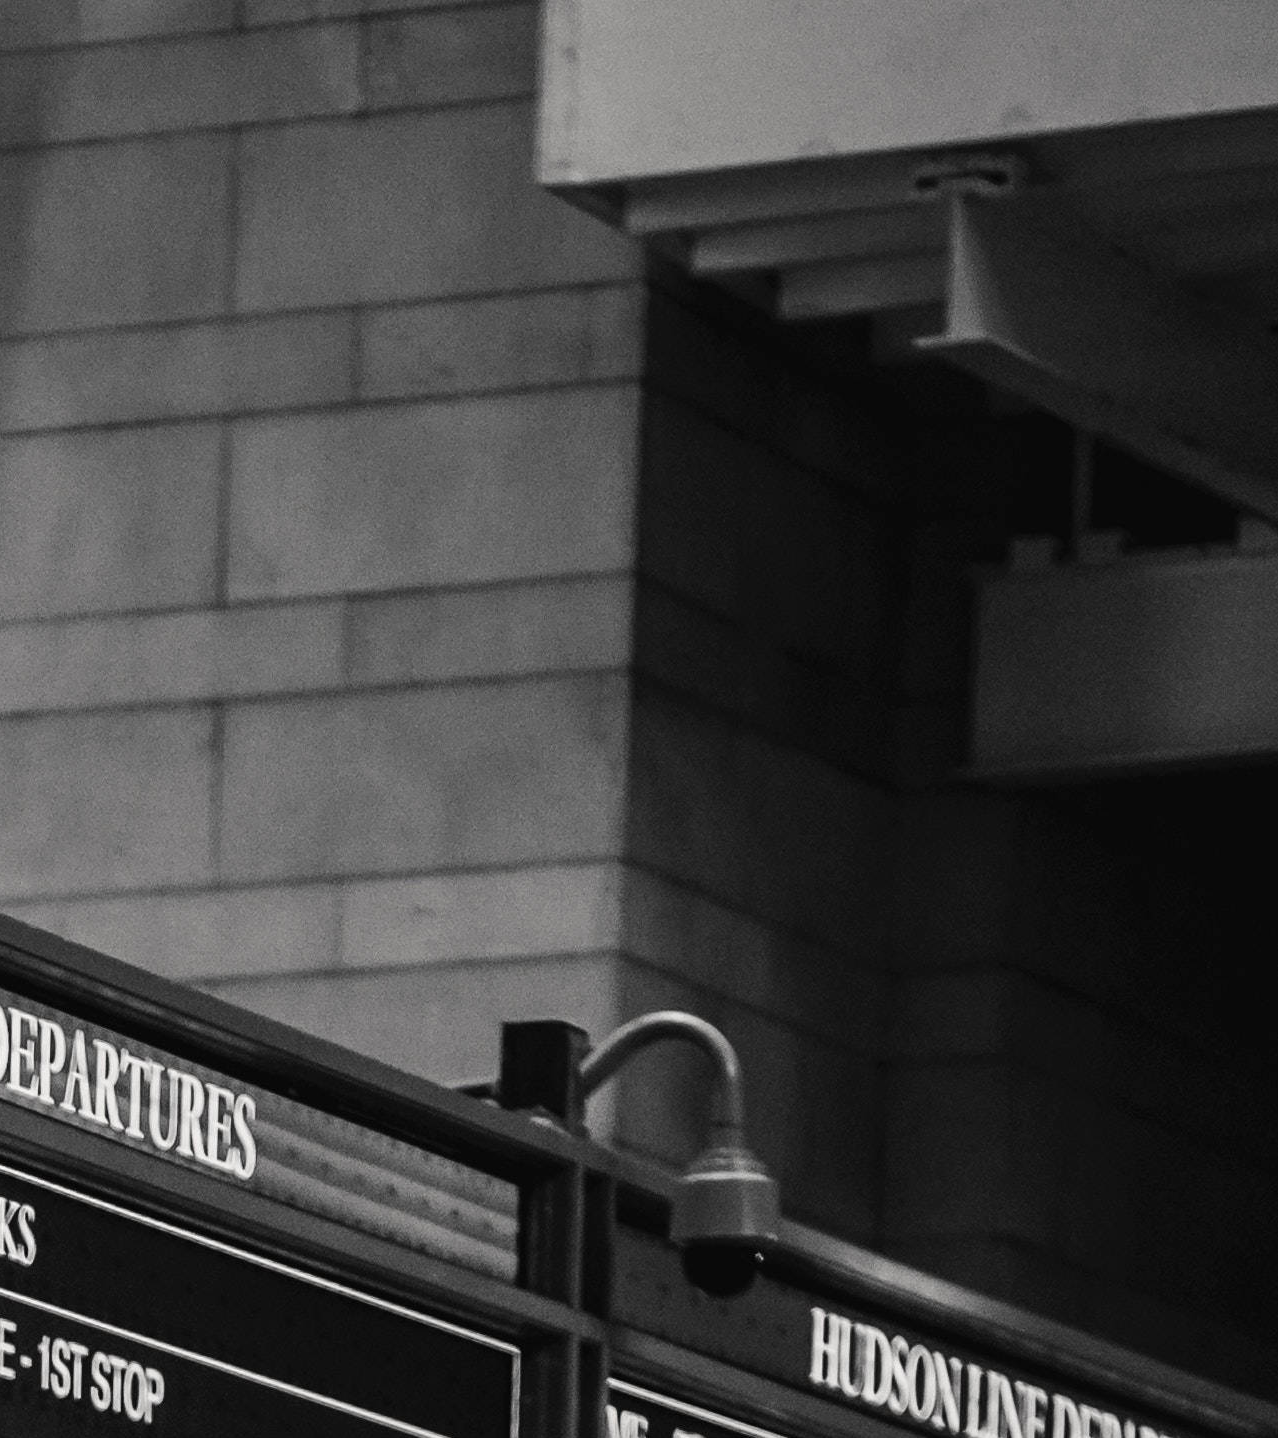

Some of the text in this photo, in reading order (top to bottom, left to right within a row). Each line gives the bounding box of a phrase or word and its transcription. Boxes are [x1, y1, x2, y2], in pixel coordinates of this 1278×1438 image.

[21, 1356, 32, 1367] -
[38, 1336, 88, 1398] 1ST
[91, 1352, 164, 1423] STOP
[808, 1307, 963, 1435] HUDSON
